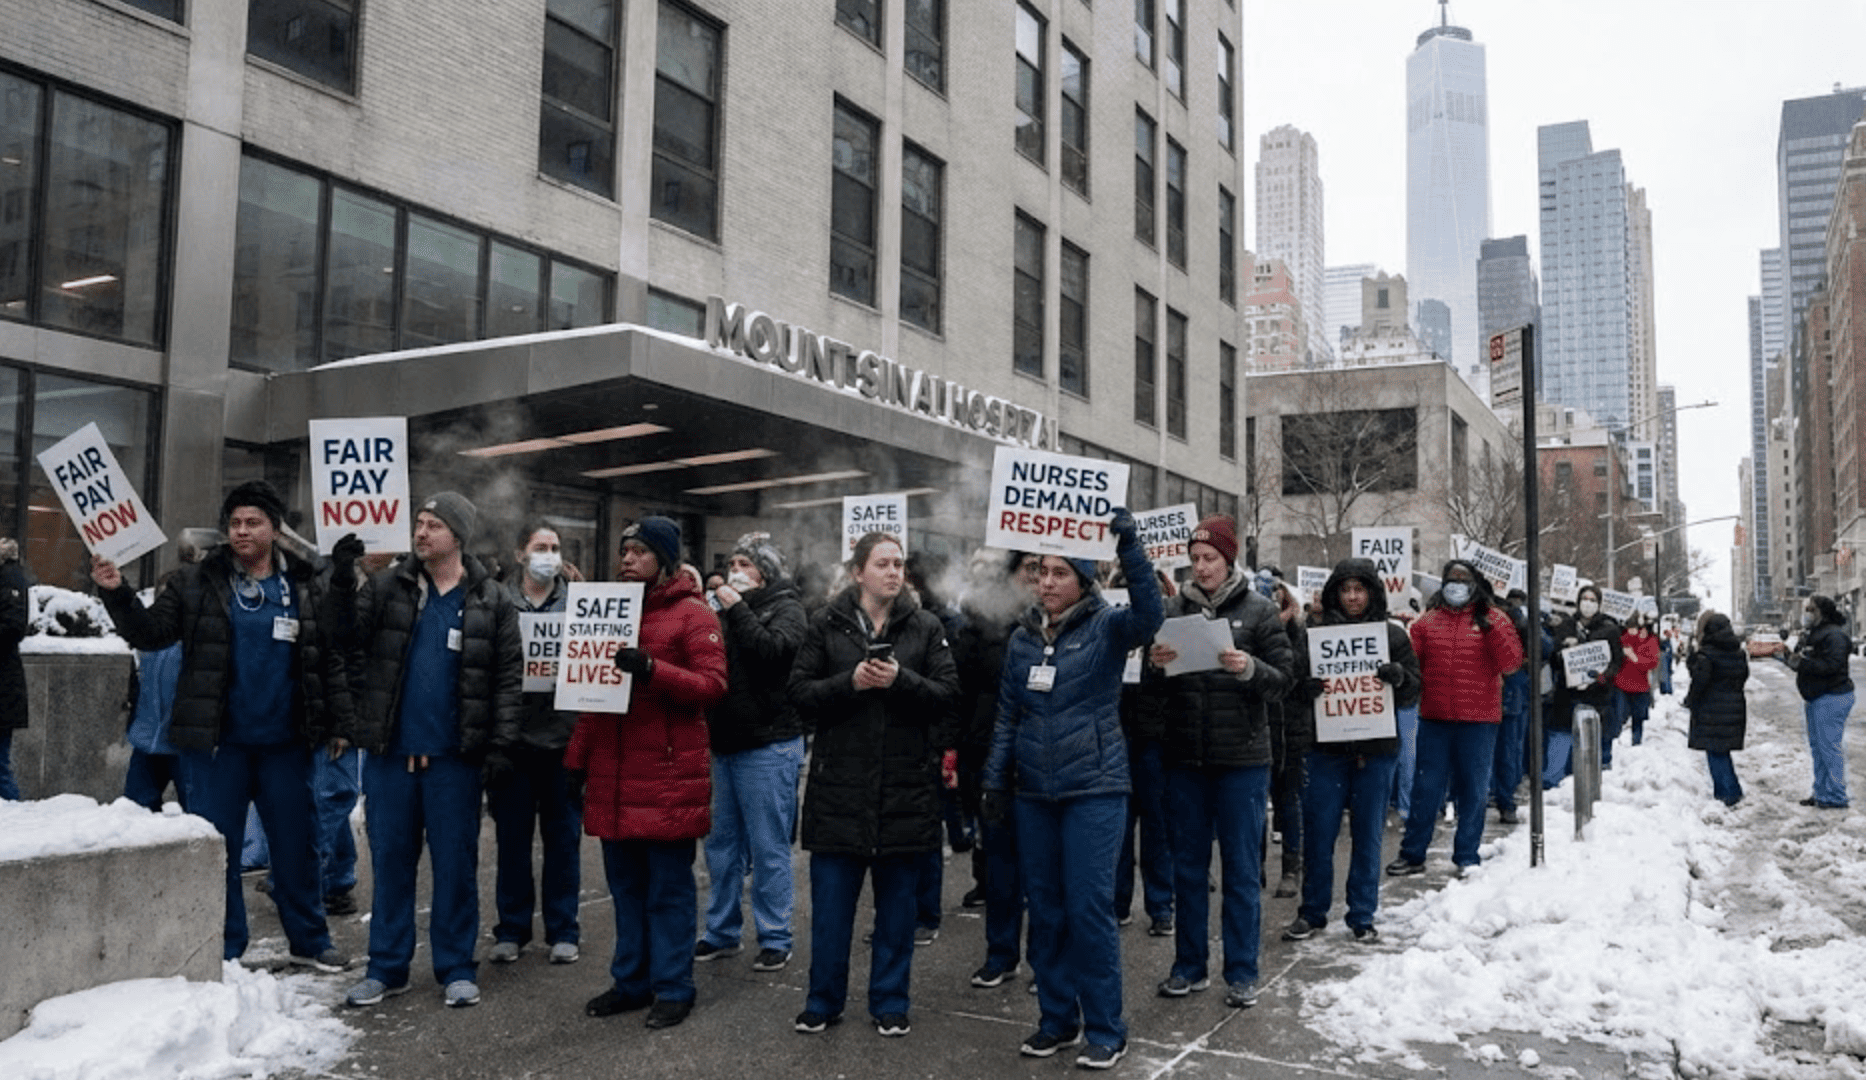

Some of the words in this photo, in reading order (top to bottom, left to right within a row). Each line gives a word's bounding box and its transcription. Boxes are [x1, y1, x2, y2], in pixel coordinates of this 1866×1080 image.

[705, 295, 856, 389] MOUNT
[323, 437, 395, 464] FAIR
[53, 446, 107, 492] FAIR
[331, 468, 389, 495] PAY
[1011, 461, 1109, 492] NURSES
[72, 474, 115, 517] PAY
[1004, 485, 1111, 517] DEMAND
[82, 498, 138, 546] NOW
[322, 499, 399, 526] NOW
[851, 504, 897, 521] SAFE
[1133, 511, 1186, 531] URSES
[1000, 510, 1110, 542] RESPECT
[1360, 538, 1404, 556] FAIR
[1375, 557, 1401, 575] AY
[575, 597, 631, 618] SAFE
[568, 622, 633, 637] STAFFING
[1320, 636, 1379, 659] SAFE
[565, 662, 623, 686] LIVES
[1322, 674, 1385, 696] SAVES
[1324, 695, 1385, 717] LIVES
